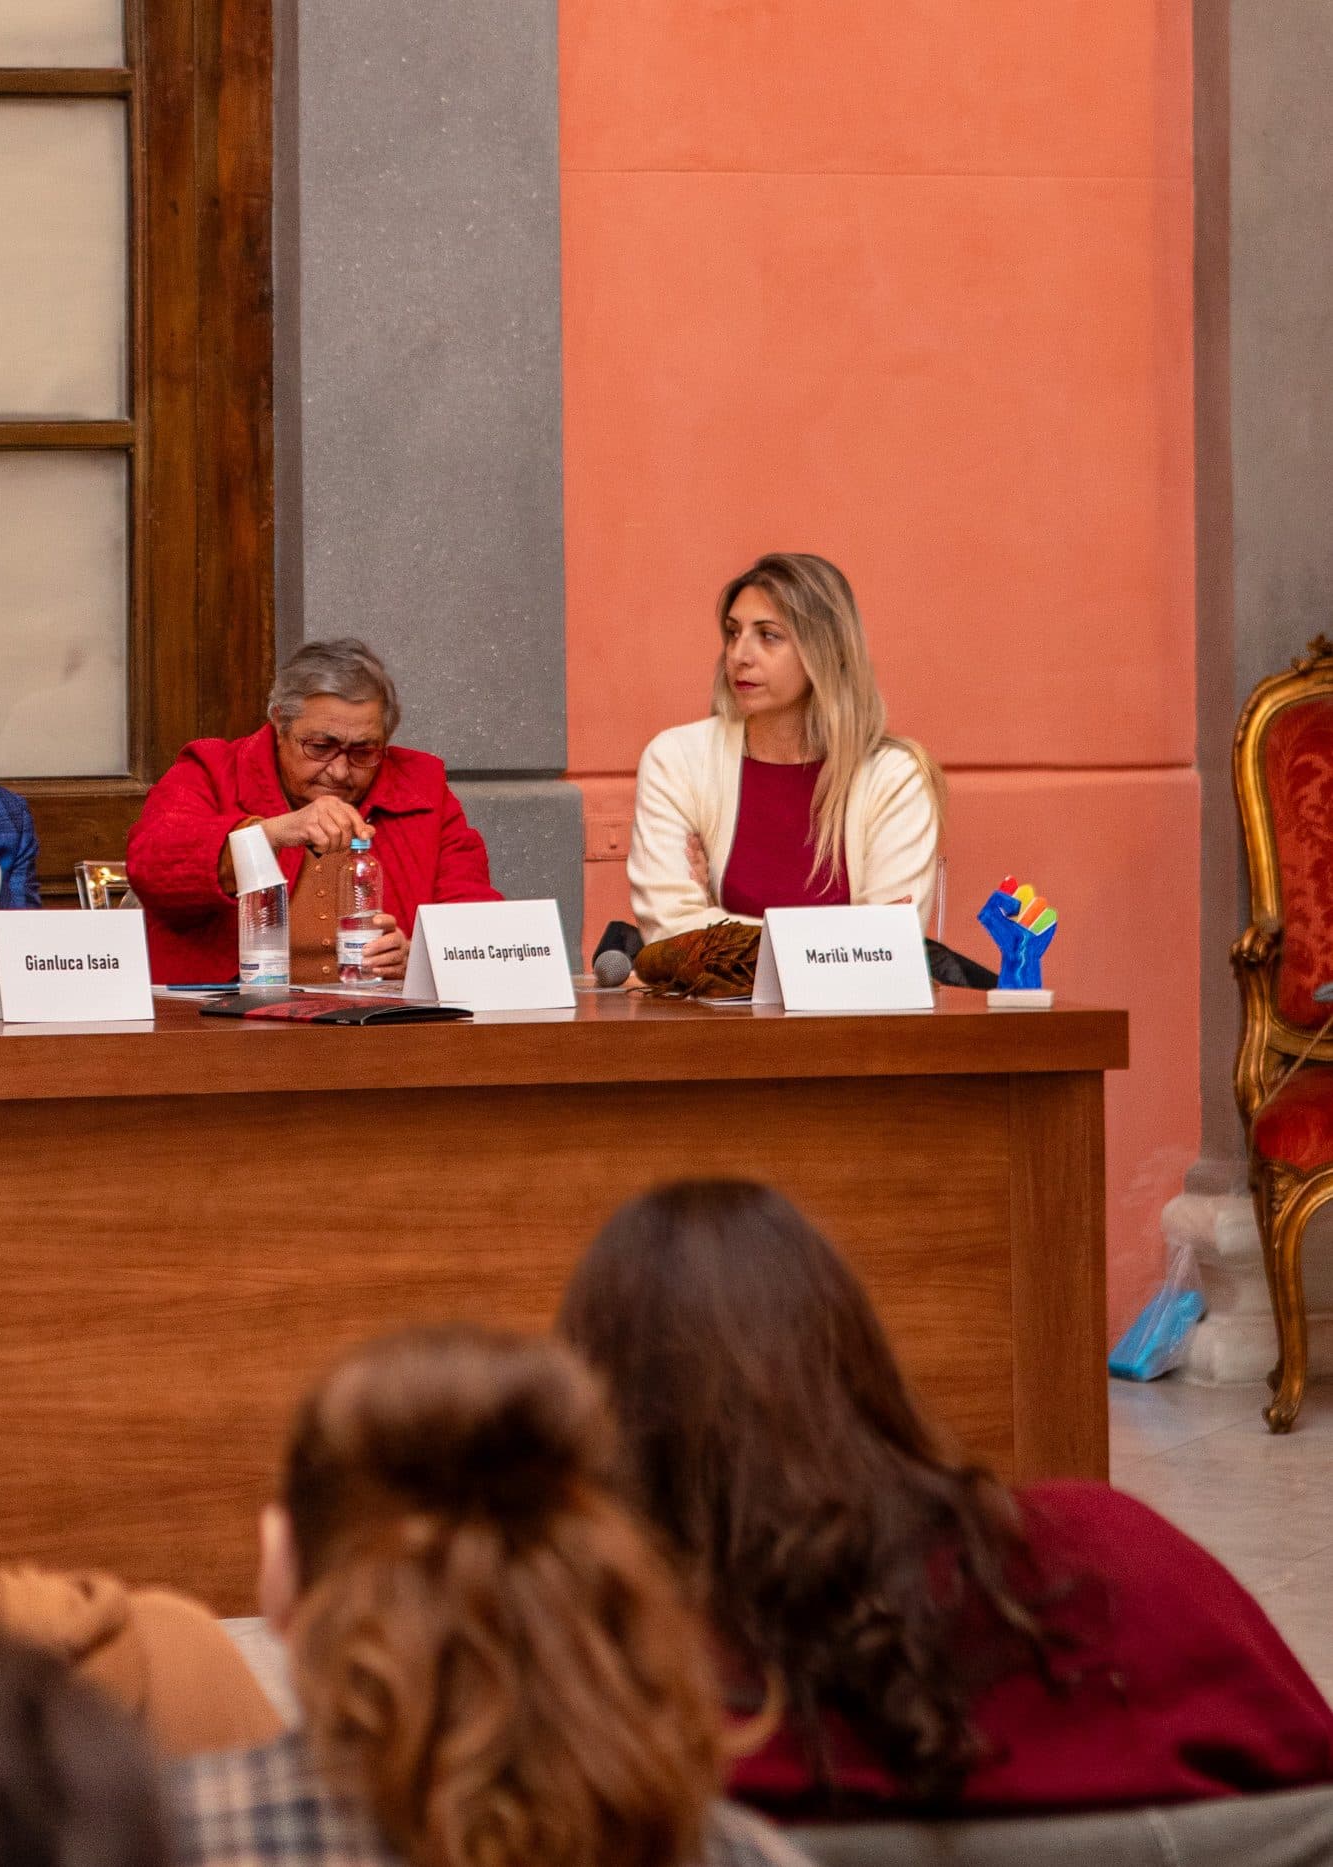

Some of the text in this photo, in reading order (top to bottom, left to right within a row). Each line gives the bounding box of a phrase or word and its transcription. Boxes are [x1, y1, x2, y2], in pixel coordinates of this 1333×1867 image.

[443, 943, 551, 962] Jolanda Capriglione
[805, 947, 893, 964] Marilù Musto
[25, 953, 119, 970] Gianluca Isaia
